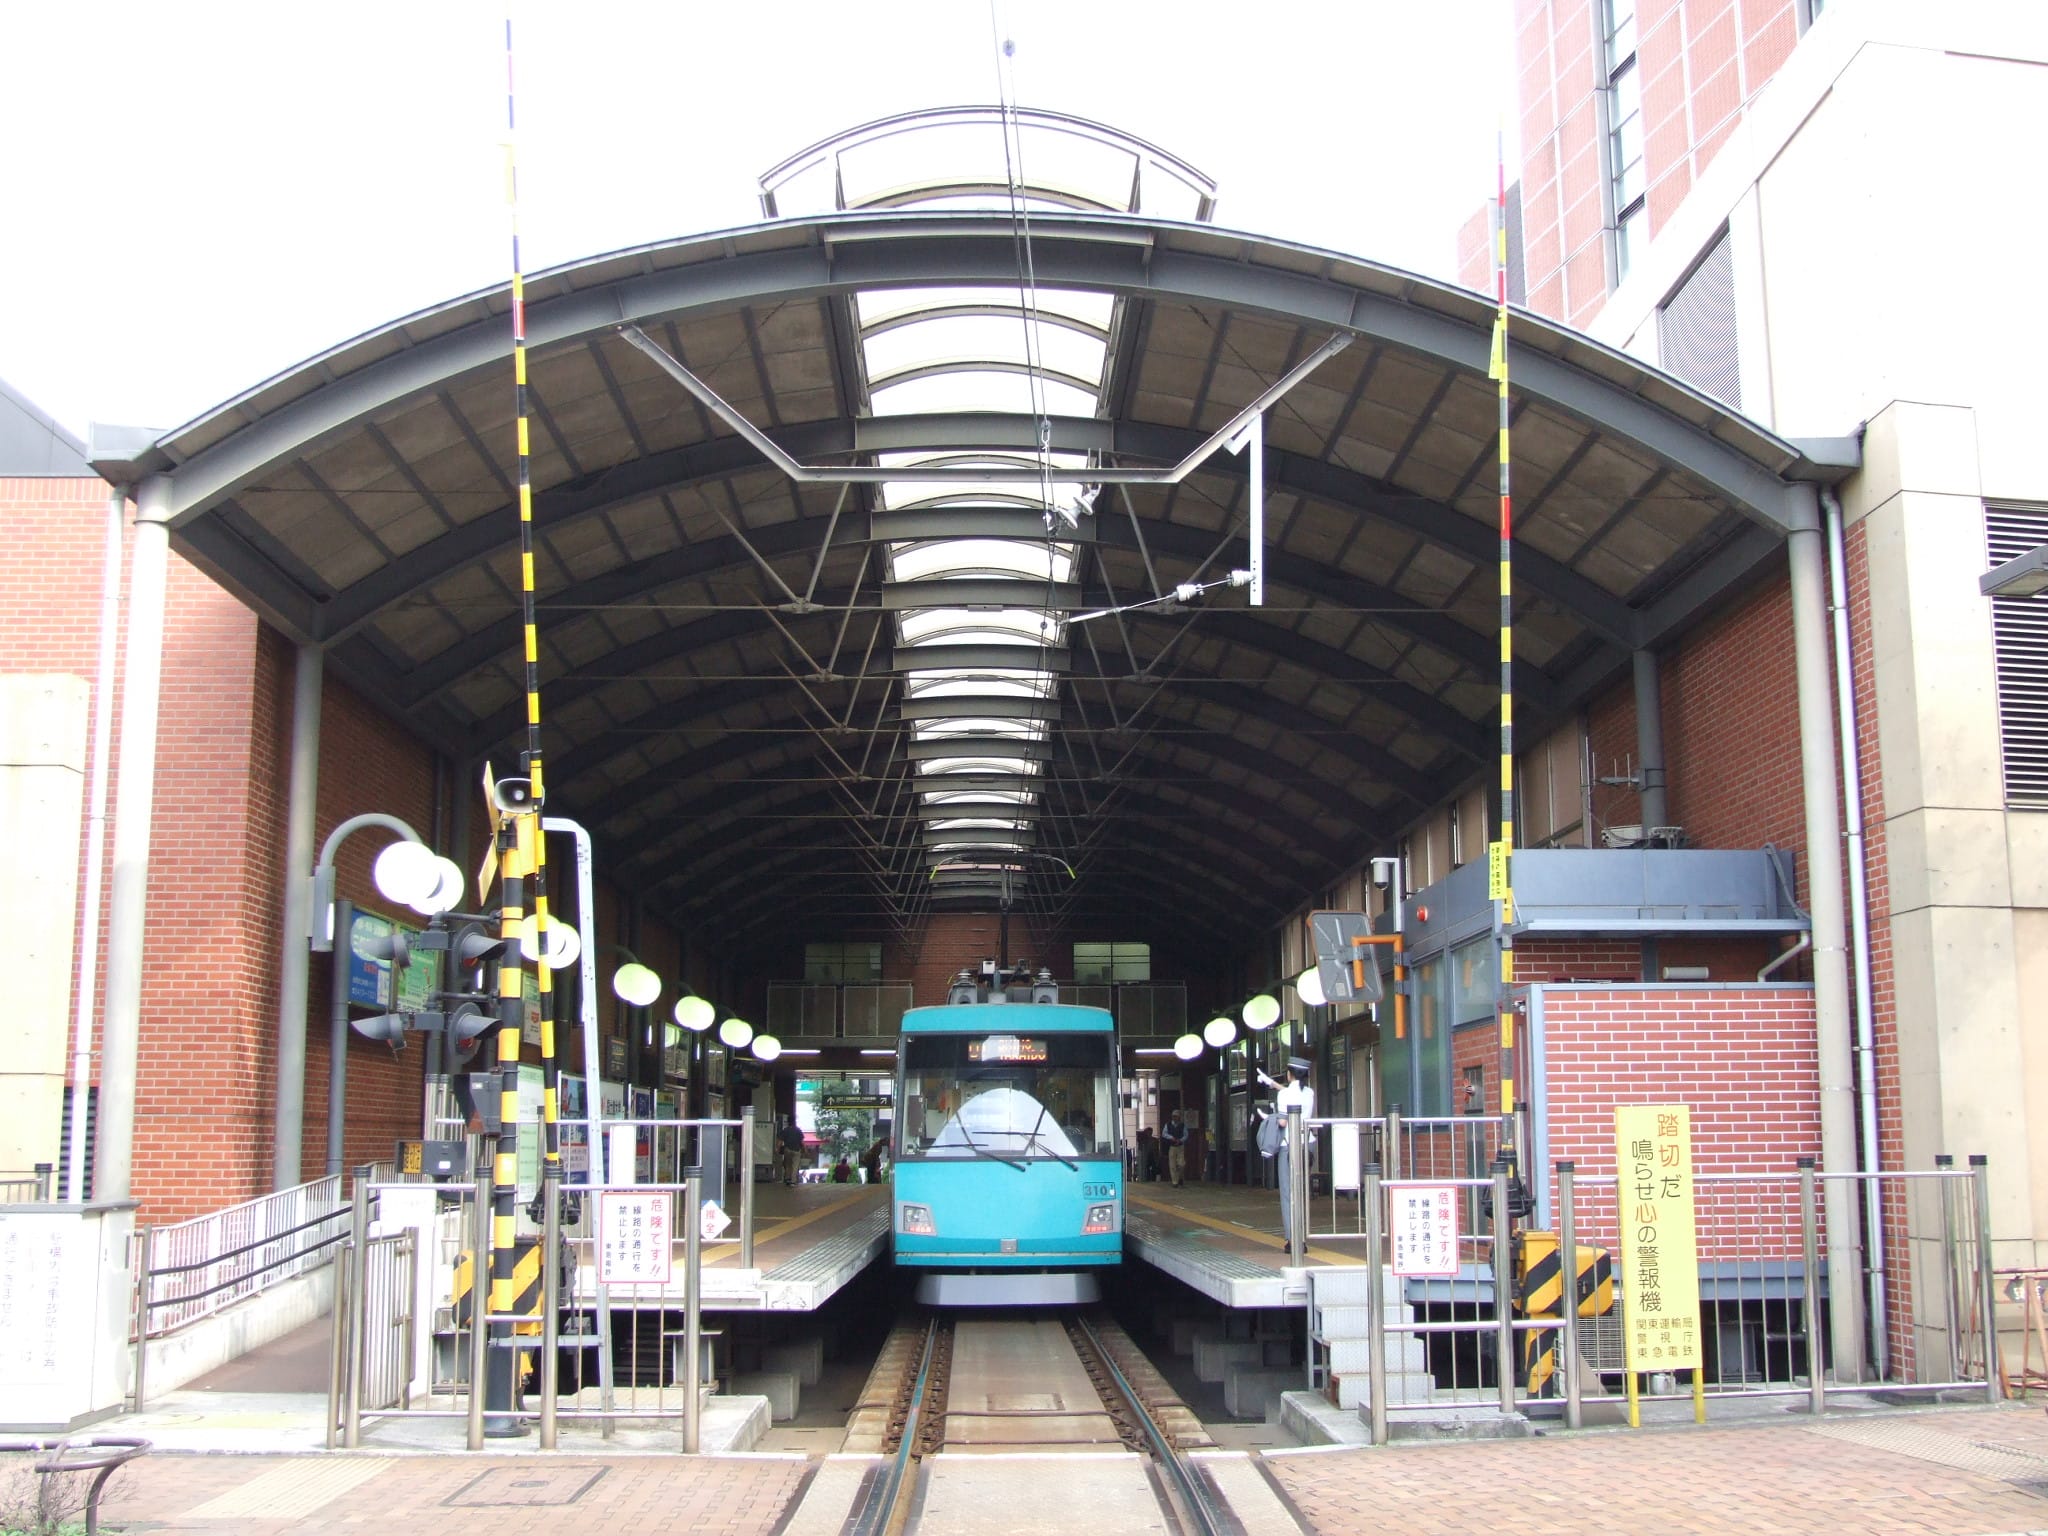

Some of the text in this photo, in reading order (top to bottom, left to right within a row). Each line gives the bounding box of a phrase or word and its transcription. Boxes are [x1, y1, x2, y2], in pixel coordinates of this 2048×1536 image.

[1657, 1113, 1682, 1199] 踏切だ
[618, 1205, 627, 1261] 禁止します
[633, 1205, 641, 1272] 線路の通行を
[1409, 1199, 1417, 1254] 禁止します
[1422, 1199, 1431, 1265] 線路の通行を
[1632, 1139, 1662, 1312] 鳴らせ心の警報機
[1636, 1317, 1693, 1330] 関東運輸局
[1638, 1345, 1693, 1358] 東急電鉄
